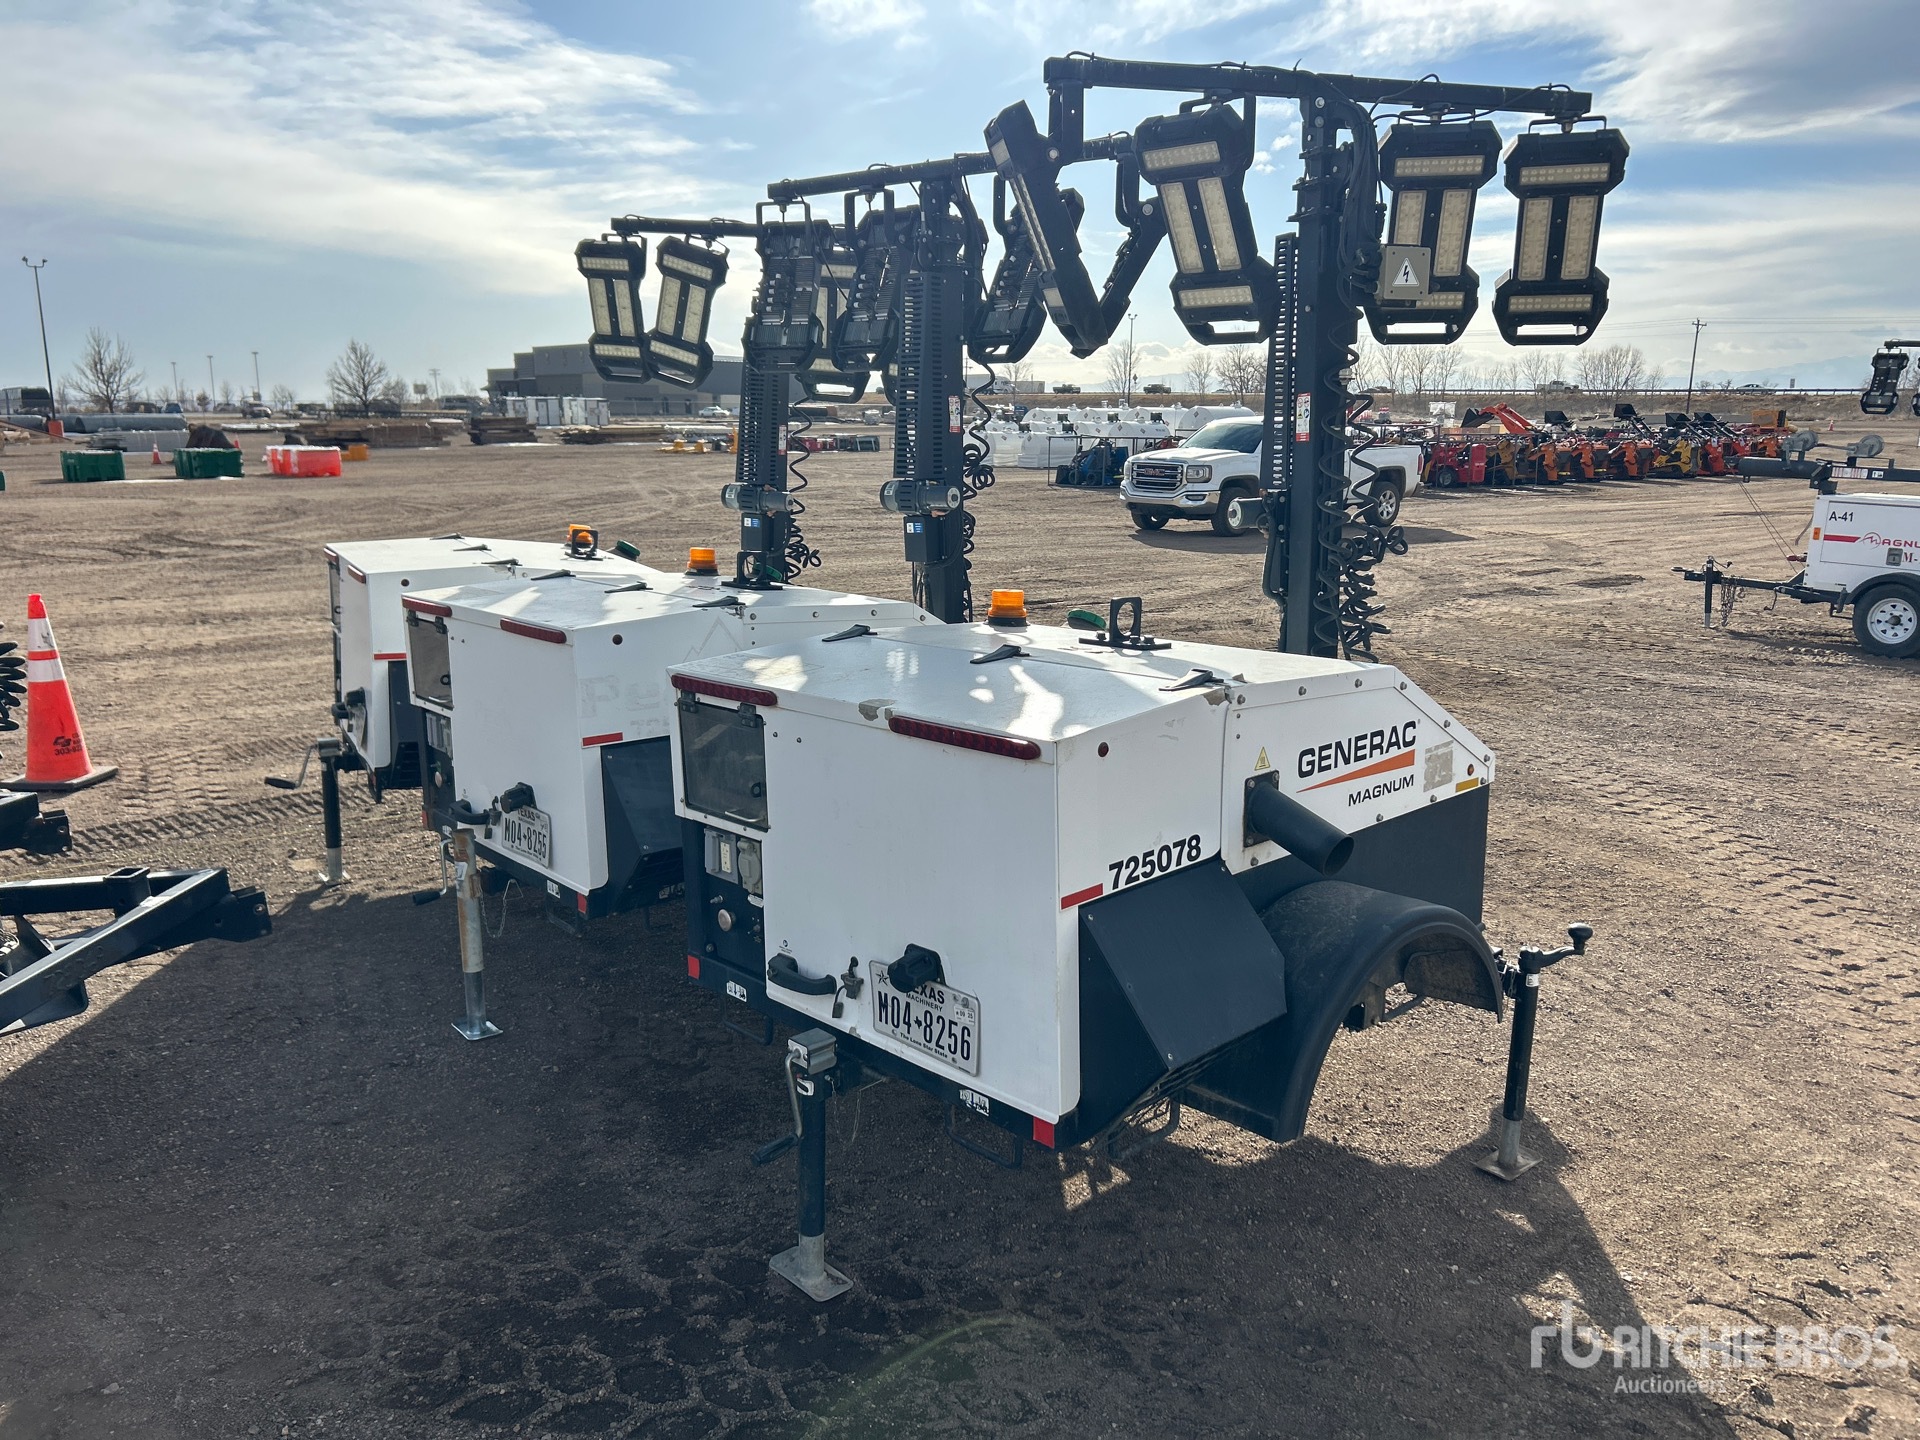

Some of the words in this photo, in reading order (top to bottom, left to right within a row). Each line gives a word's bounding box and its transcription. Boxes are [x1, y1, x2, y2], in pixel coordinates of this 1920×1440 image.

[1828, 510, 1854, 522] A-41
[1297, 720, 1417, 779] GENERAC
[1348, 774, 1415, 807] MAGNUM
[1108, 833, 1202, 890] 725078
[905, 992, 944, 1013] MACHINERY
[912, 984, 946, 1005] EXAS
[899, 1031, 910, 1042] The
[910, 1036, 923, 1047] Lone
[922, 1041, 934, 1052] Star
[934, 1047, 948, 1060] State
